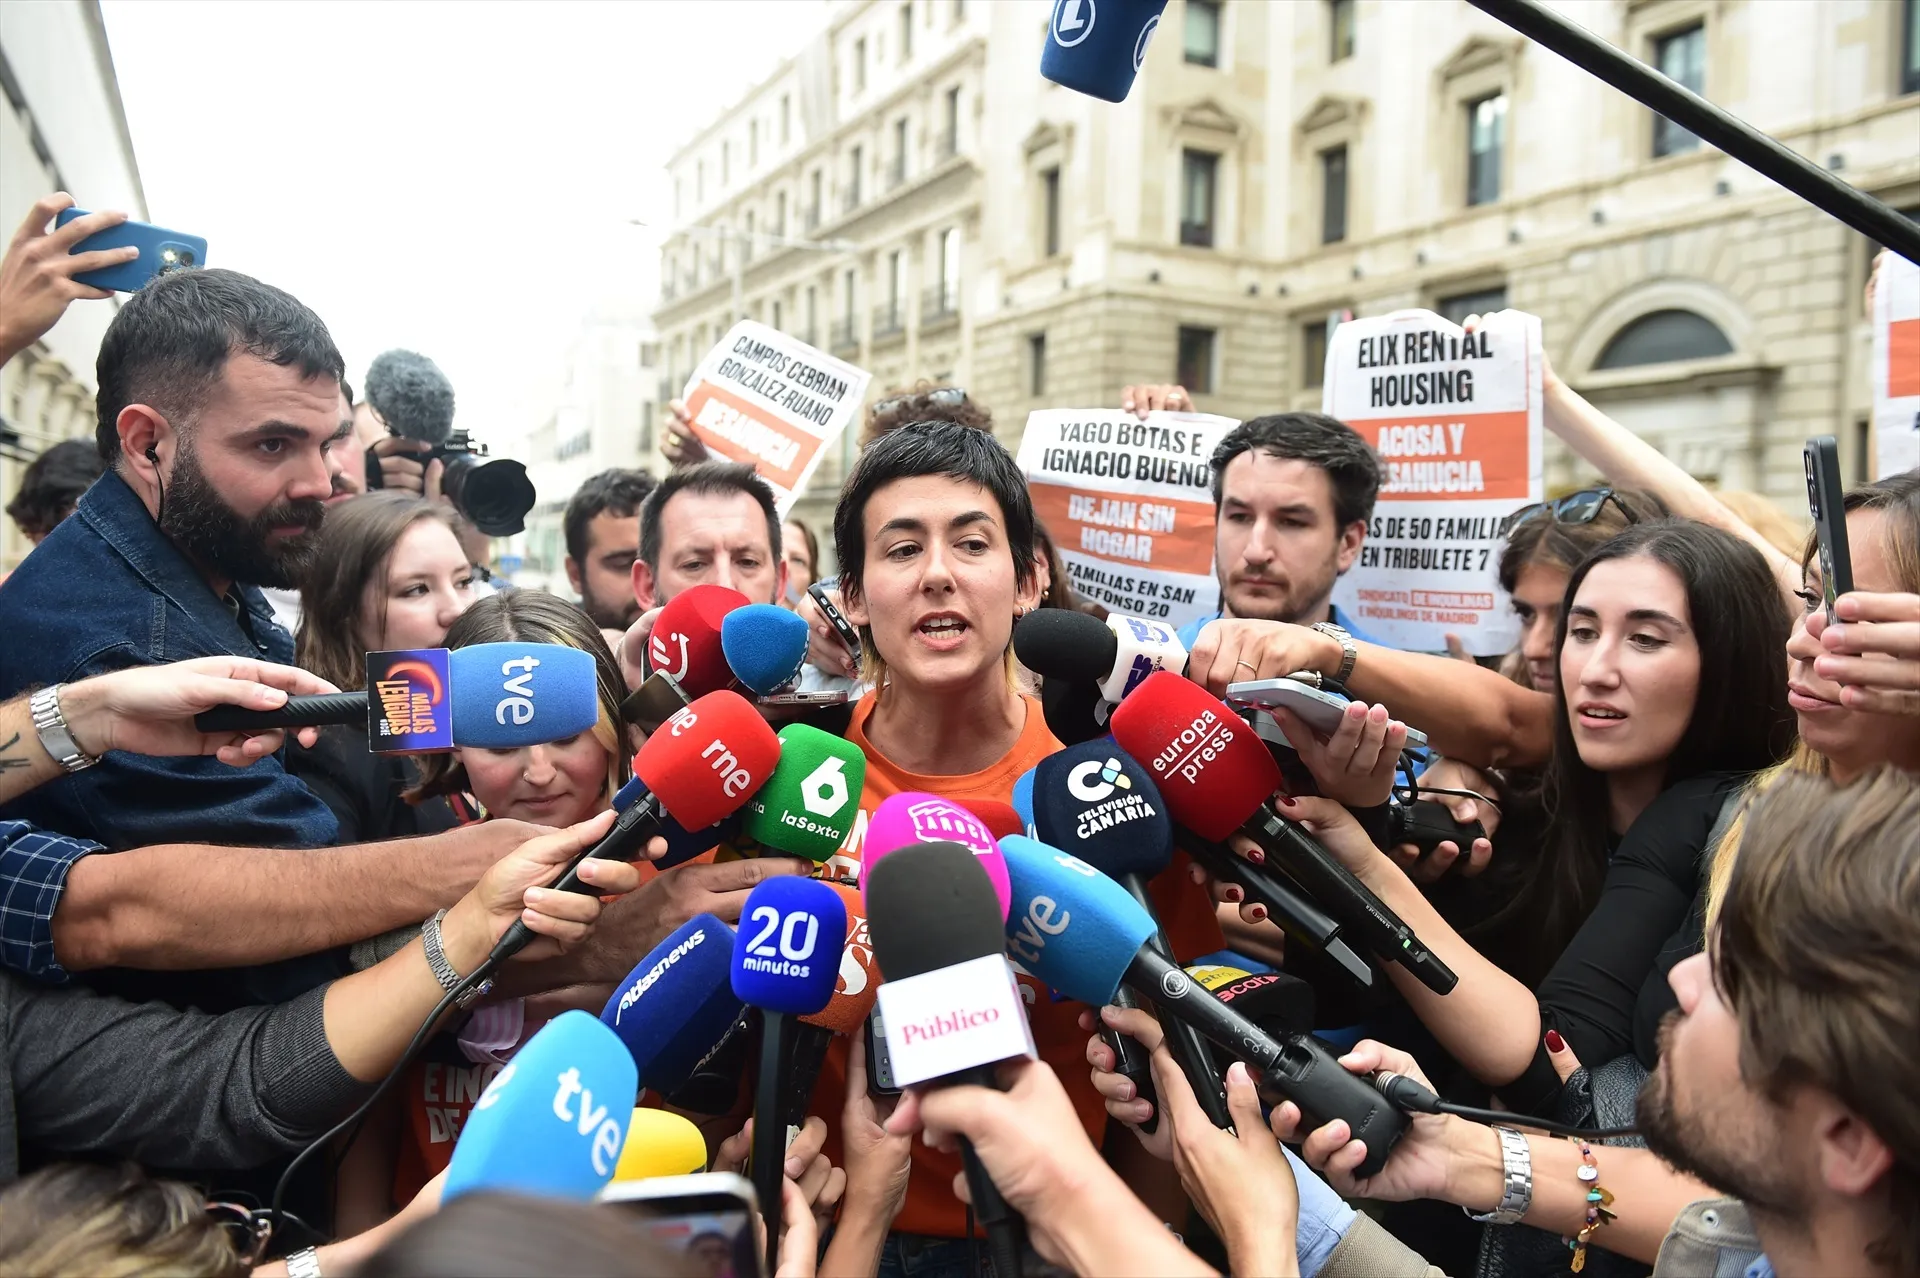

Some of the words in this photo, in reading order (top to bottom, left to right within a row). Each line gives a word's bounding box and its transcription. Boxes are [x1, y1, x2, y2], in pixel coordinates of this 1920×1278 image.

[733, 336, 791, 373] CAMPOS
[787, 362, 848, 402] CEBRIAN
[1358, 334, 1398, 368] ELIX
[718, 358, 834, 426] GONZÁLEZ-RUANO
[1371, 369, 1473, 407] HOUSING
[1060, 422, 1112, 444] YAGO
[1117, 423, 1185, 454] BOTAS
[1192, 433, 1203, 456] E
[1377, 424, 1446, 457] ACOSA
[1448, 423, 1466, 455] Y
[1042, 448, 1131, 479] IGNACIO
[1135, 454, 1208, 488] BUENO
[1068, 494, 1137, 529] DEJAN
[1138, 503, 1175, 533] SIN
[1386, 517, 1409, 539] DE
[1410, 517, 1431, 540] 50
[1435, 516, 1509, 541] FAMILIA
[1081, 527, 1152, 562] HOGAR
[1361, 546, 1379, 567] EN
[1384, 547, 1472, 571] TRIBULETE
[1479, 549, 1490, 571] 7
[1066, 562, 1134, 592] FAMILIAS
[1138, 581, 1159, 597] EN
[1161, 585, 1195, 604] SAN
[1147, 602, 1170, 618] 20
[1436, 611, 1479, 625] MADRID
[376, 680, 411, 735] LENGUAS
[495, 655, 541, 725] tve
[411, 692, 437, 734] MALAS
[1152, 709, 1217, 773] europa
[1181, 726, 1234, 785] press
[701, 739, 751, 798] rne
[800, 756, 849, 818] 6
[781, 809, 841, 840] laSexta
[1076, 802, 1156, 840] CANARIA
[1077, 793, 1144, 824] TELEVISIÓN
[745, 906, 819, 961] 20
[1007, 895, 1071, 963] tve
[615, 928, 706, 1026] Atlasnews
[743, 956, 810, 978] minutos
[902, 1007, 1000, 1046] Público
[552, 1066, 622, 1177] tve
